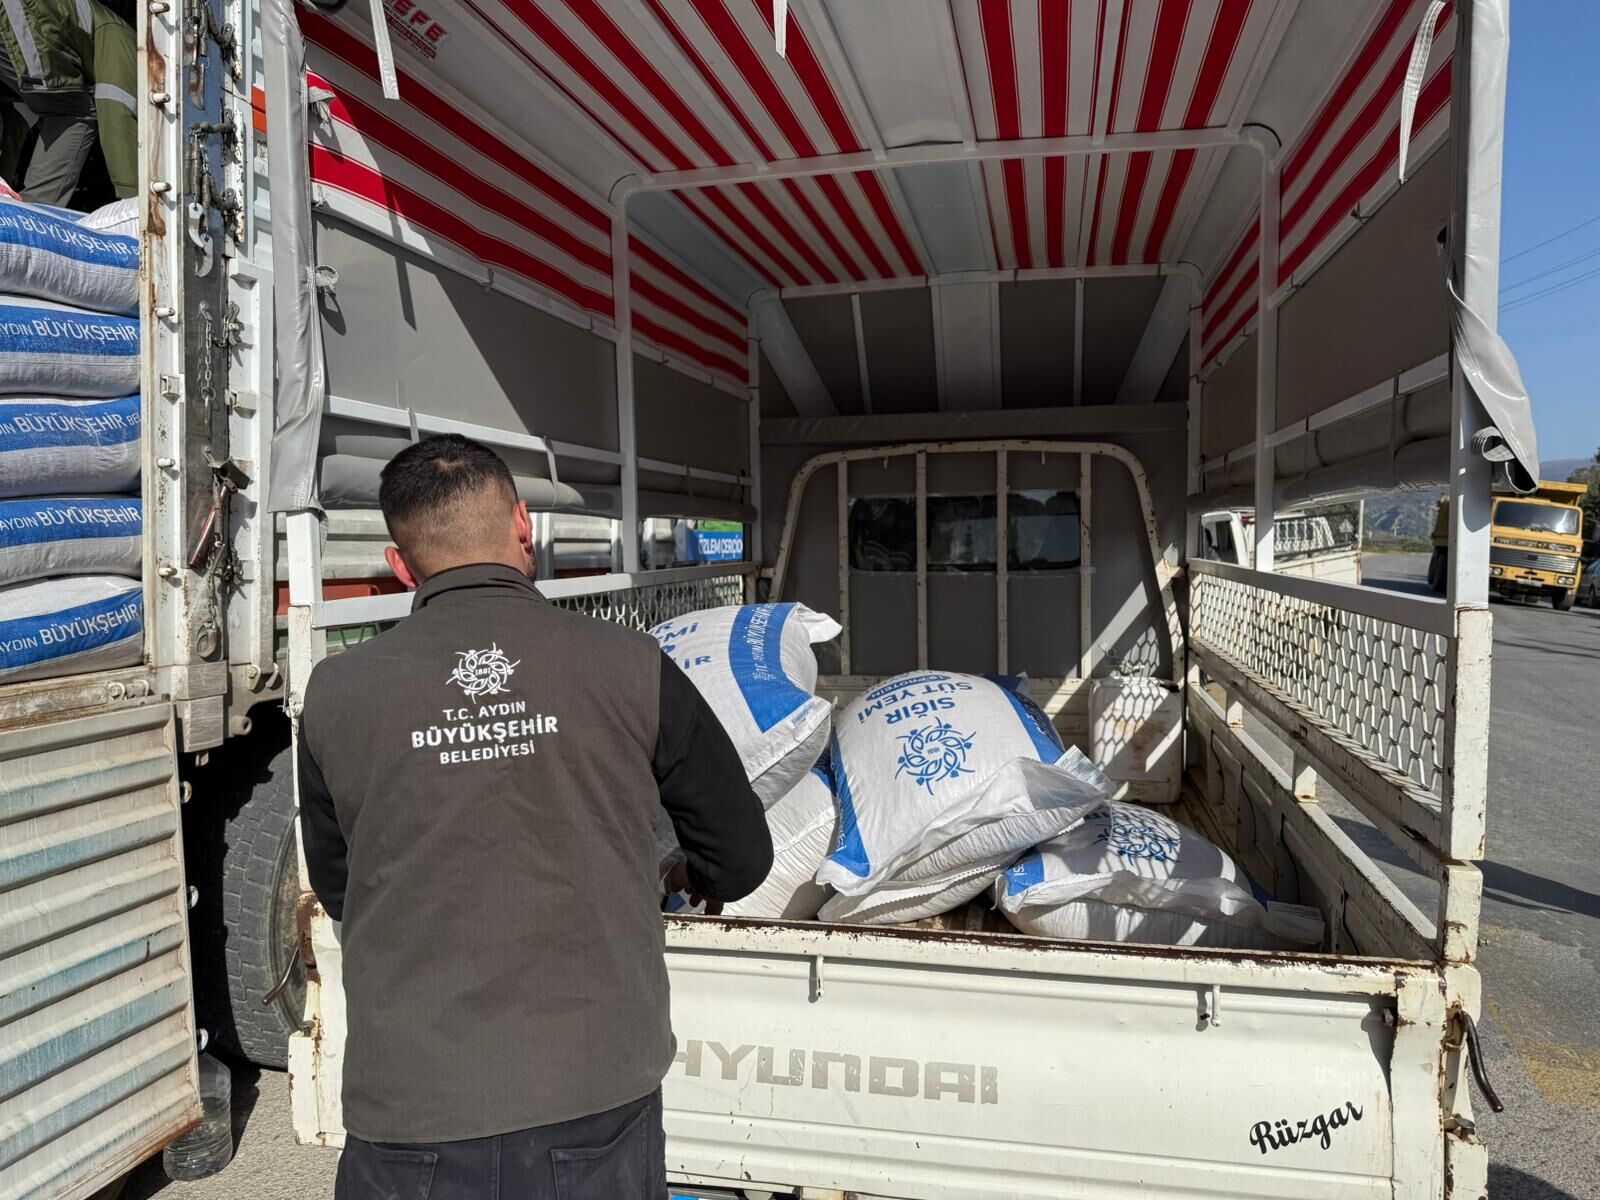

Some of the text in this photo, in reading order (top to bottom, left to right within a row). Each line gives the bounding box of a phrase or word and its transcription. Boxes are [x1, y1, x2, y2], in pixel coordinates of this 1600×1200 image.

[18, 214, 131, 256] BÜYÜKŞEHİR
[32, 318, 138, 344] BÜYÜKŞEHİR
[13, 413, 127, 437] BÜYÜKŞEHİR
[36, 507, 142, 528] BÜYÜKŞEHİR
[39, 603, 139, 646] BÜYÜKŞEHİR
[442, 701, 526, 721] T.C. AYDIN
[857, 681, 974, 725] SÜT YEMİ
[884, 697, 956, 725] SIĞIR
[411, 714, 559, 749] BÜYÜKŞEHİR
[439, 740, 535, 765] BELEDİYESİ
[1249, 1101, 1363, 1154] Rüzgar
